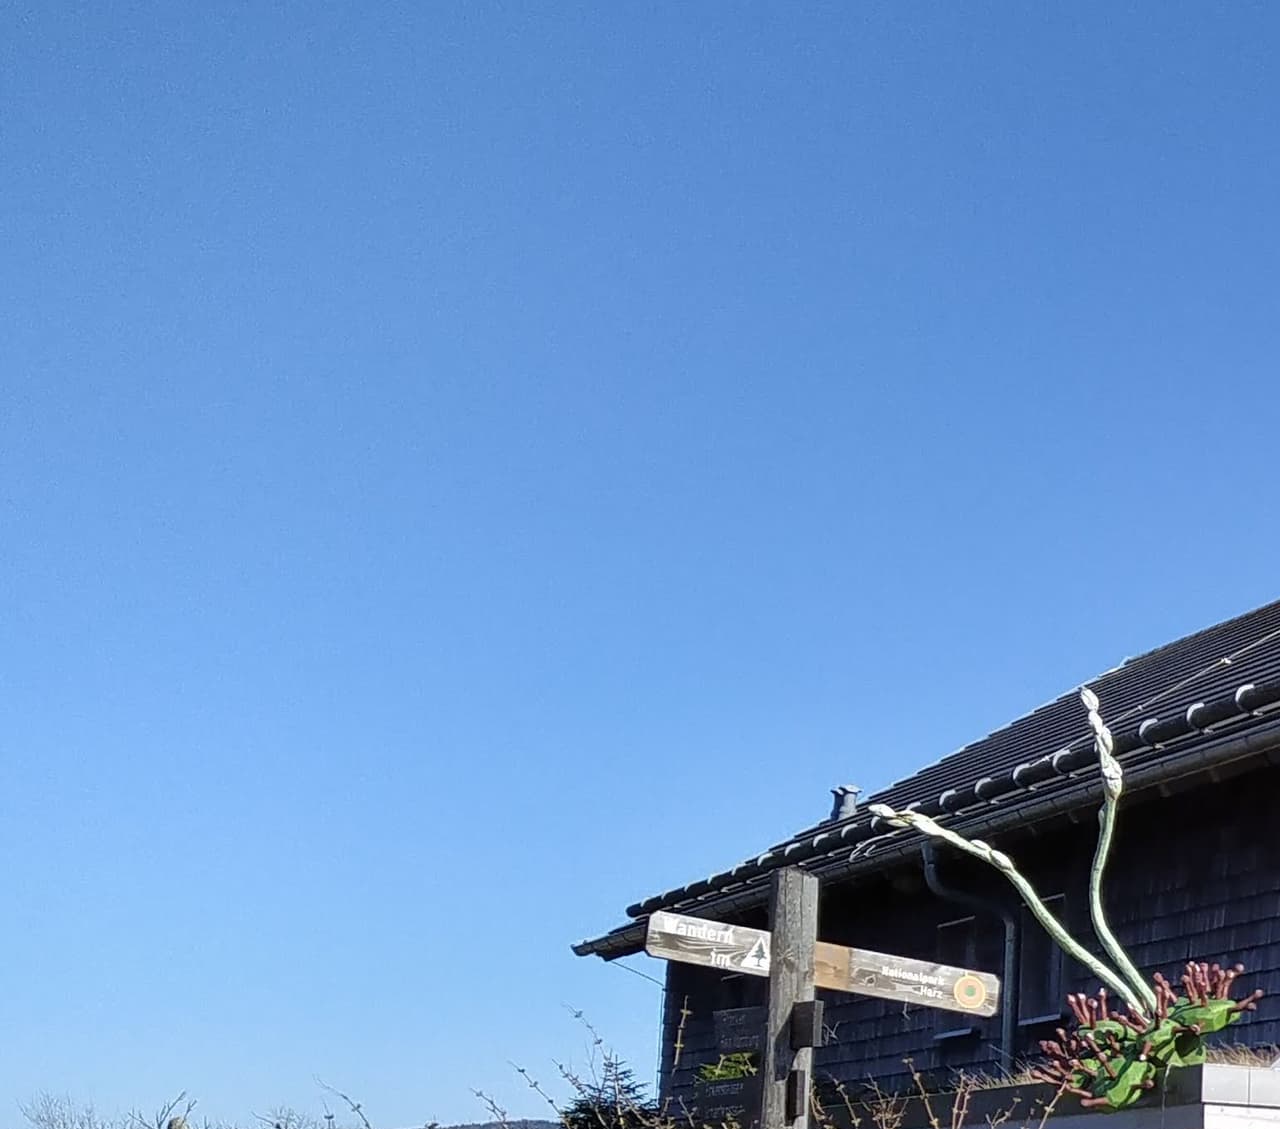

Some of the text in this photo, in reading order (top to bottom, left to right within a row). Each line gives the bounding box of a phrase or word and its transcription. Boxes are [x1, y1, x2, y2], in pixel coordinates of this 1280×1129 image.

[663, 916, 735, 943] Wandern
[882, 966, 945, 986] Nationalpark
[920, 985, 944, 999] Harz
